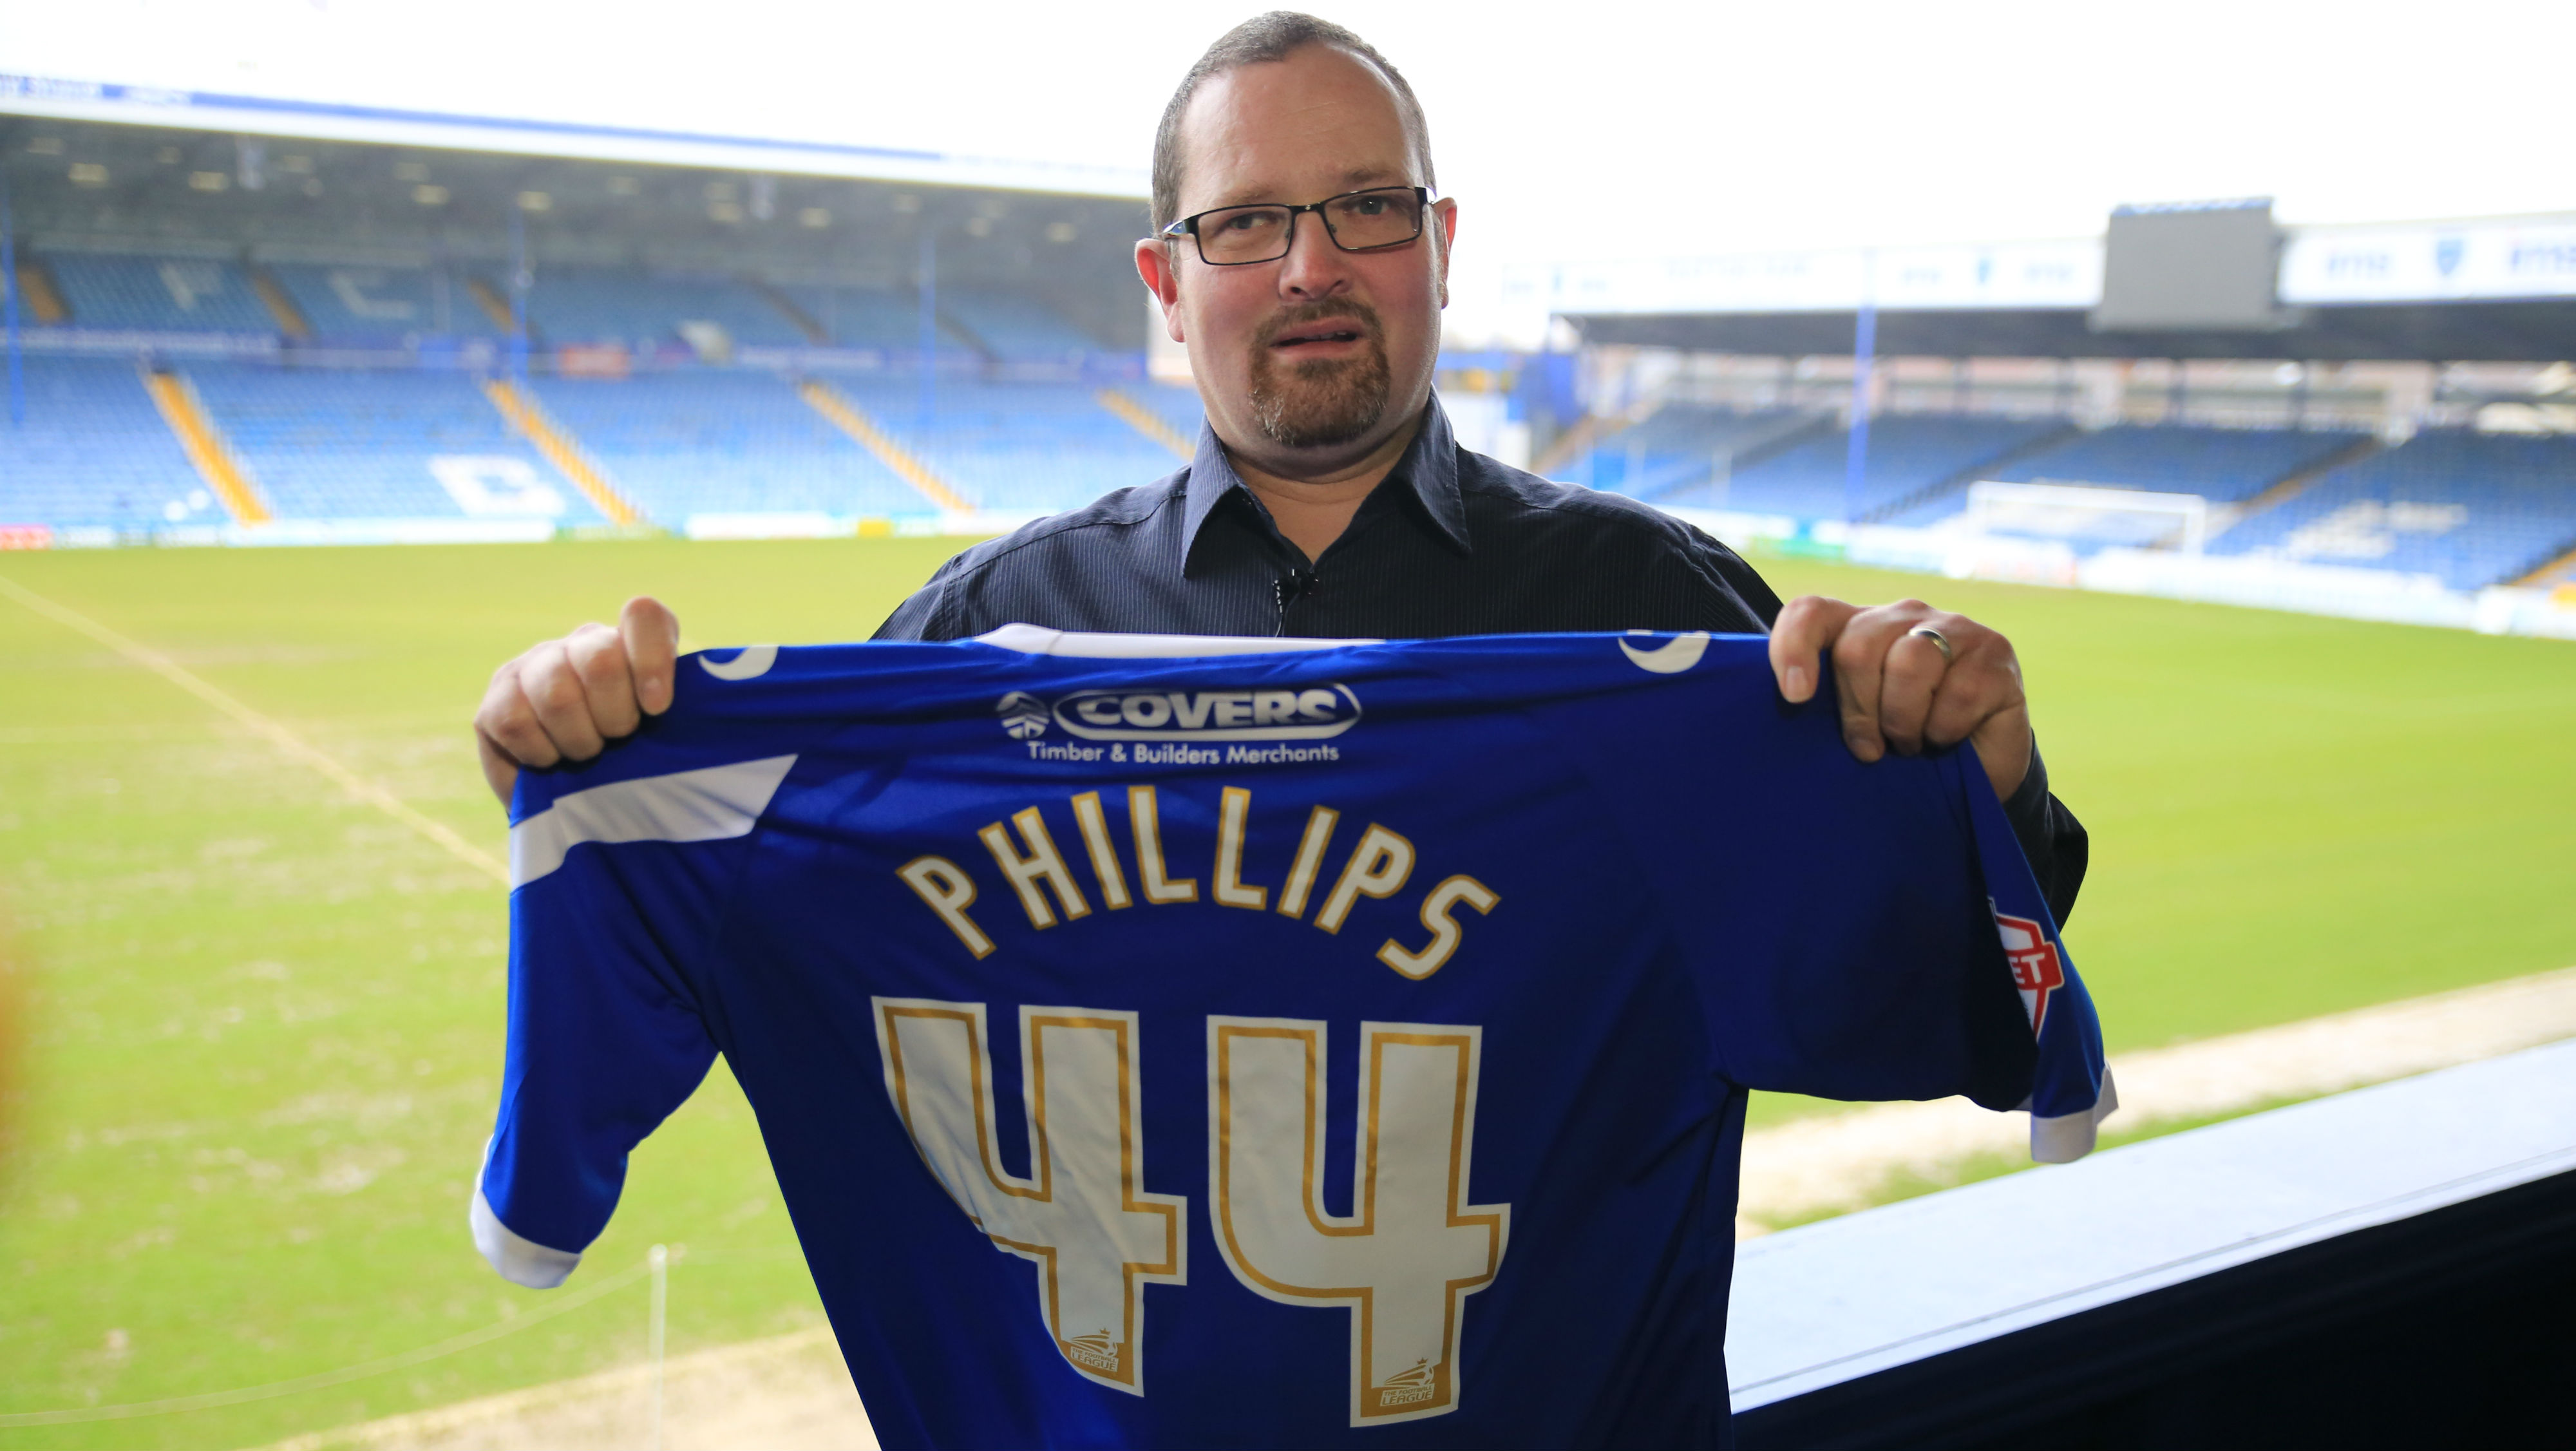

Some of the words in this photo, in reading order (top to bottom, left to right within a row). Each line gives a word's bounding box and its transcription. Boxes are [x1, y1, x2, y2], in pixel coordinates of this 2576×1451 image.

[1077, 689, 1337, 728] COVERS
[1027, 741, 1104, 761] Timber
[1110, 743, 1127, 763] &
[1134, 743, 1220, 764] Builders
[1226, 743, 1340, 764] Merchants
[895, 784, 1501, 980] PHILLIPS
[2008, 953, 2045, 984] ET
[871, 996, 1511, 1427] 44
[1072, 1352, 1116, 1371] LEAGUE
[1382, 1390, 1432, 1405] LEAGUE
